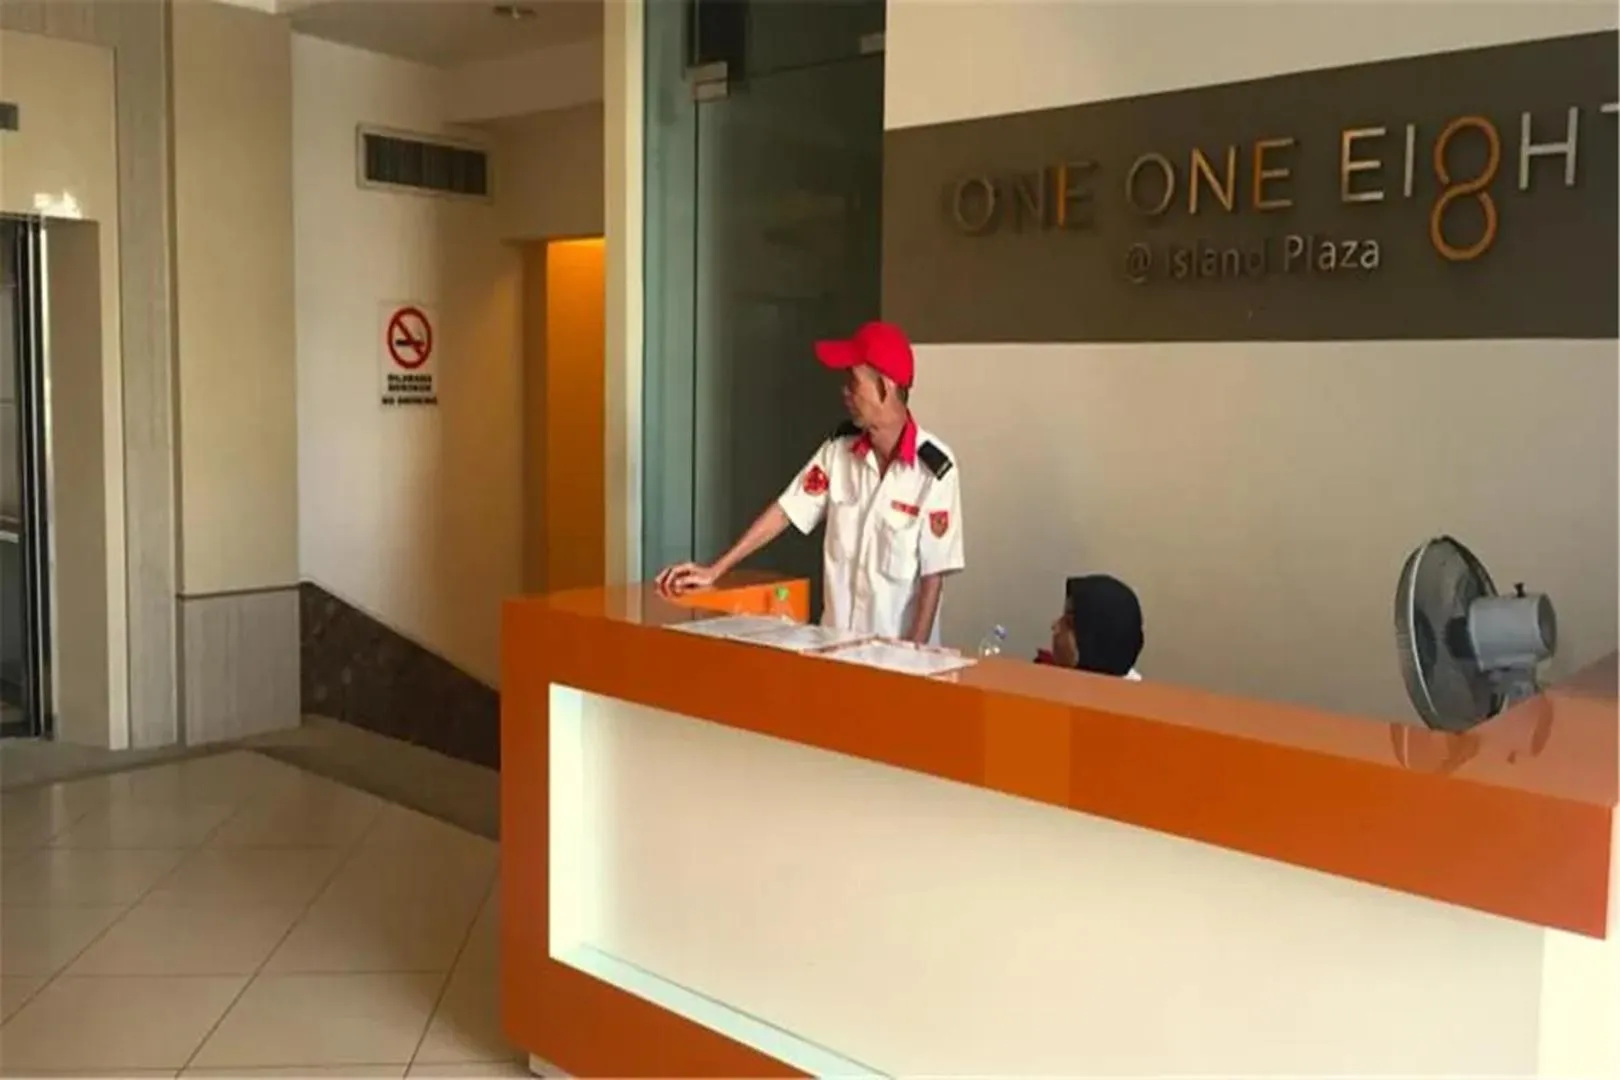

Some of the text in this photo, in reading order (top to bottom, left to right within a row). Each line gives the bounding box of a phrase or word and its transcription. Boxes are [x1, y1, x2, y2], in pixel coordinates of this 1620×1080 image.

[952, 160, 1095, 235] ONE
[1125, 137, 1294, 215] ONE
[1125, 234, 1381, 284] @ Island Plaza
